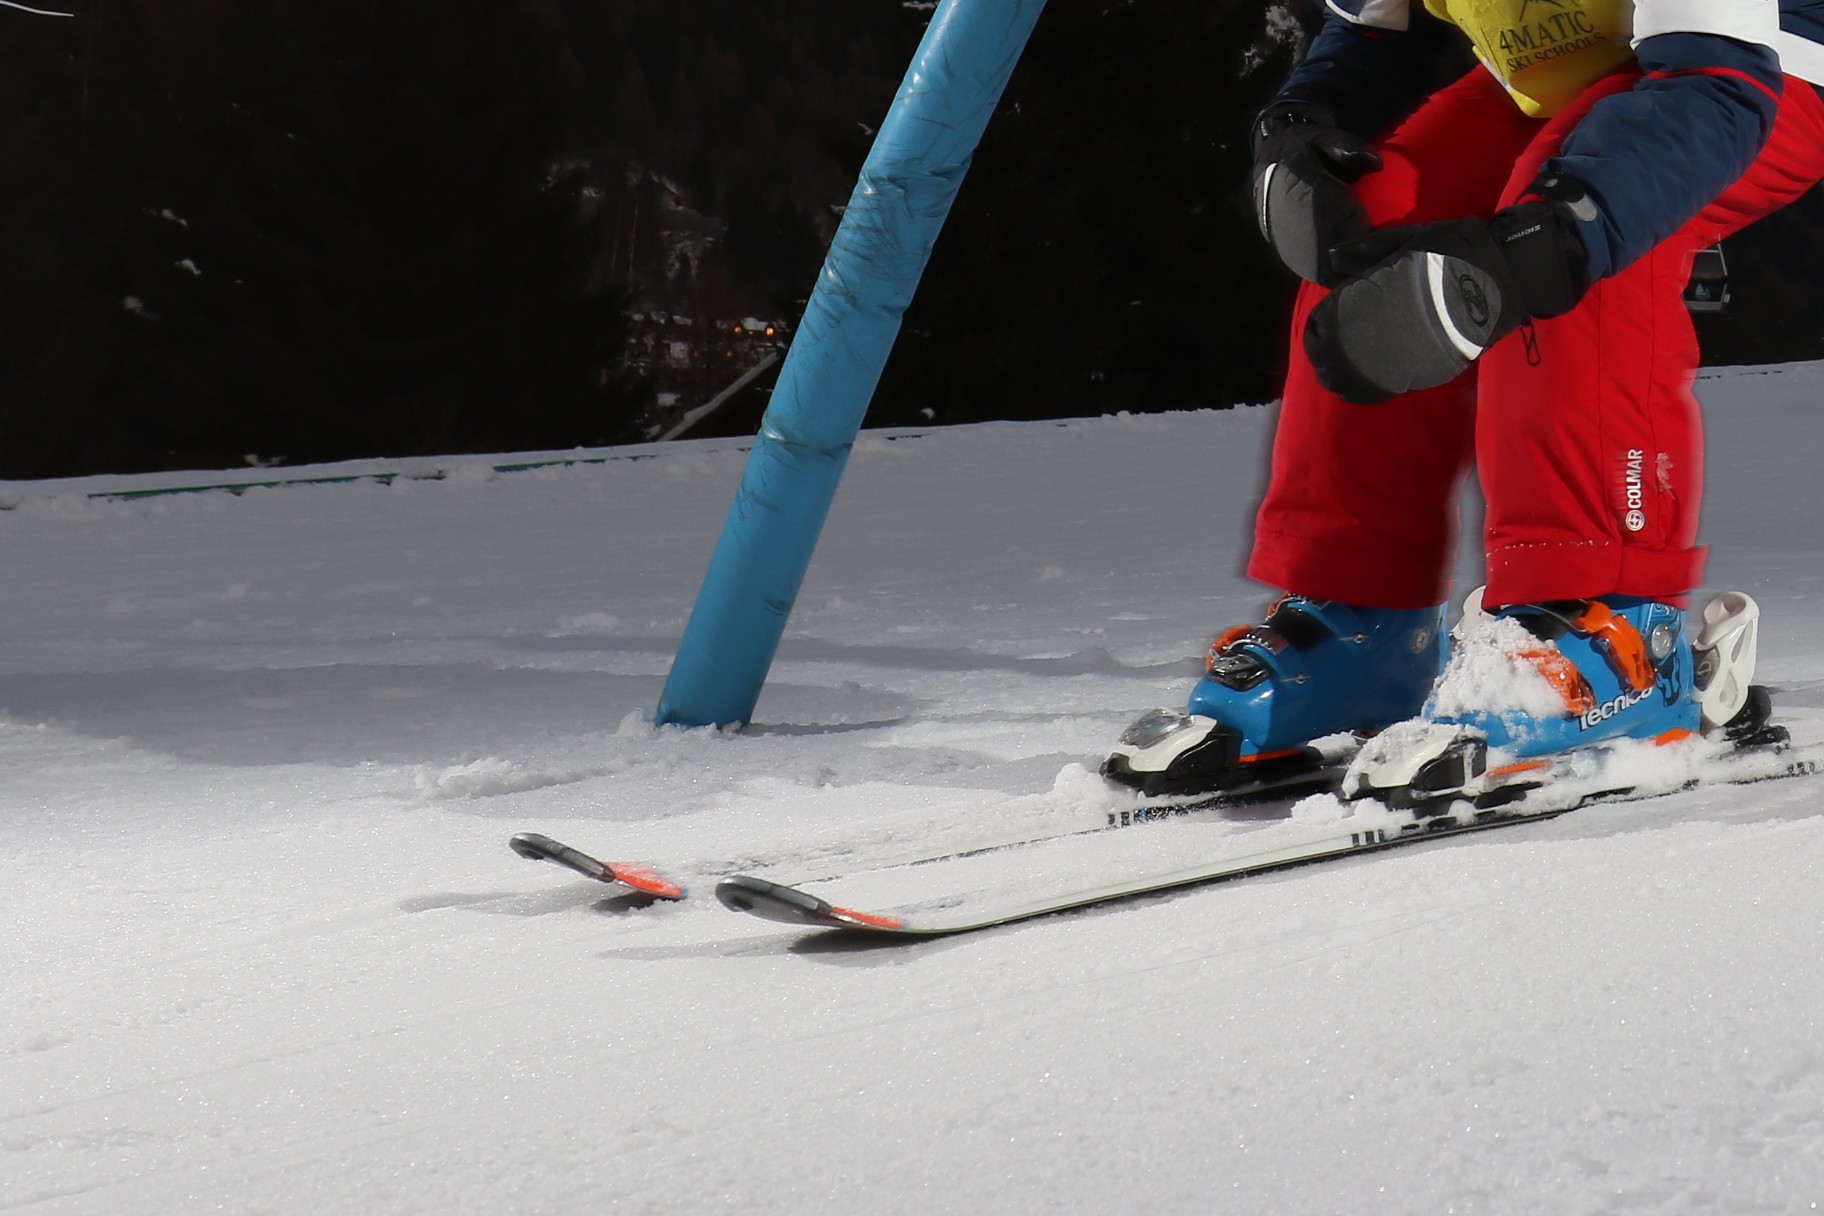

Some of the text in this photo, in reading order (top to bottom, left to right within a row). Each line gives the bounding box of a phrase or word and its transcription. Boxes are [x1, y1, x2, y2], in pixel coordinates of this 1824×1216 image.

[1500, 10, 1594, 55] 4MATIC
[1506, 32, 1606, 74] SKI SCHOOLS
[1627, 448, 1643, 510] COLMAR
